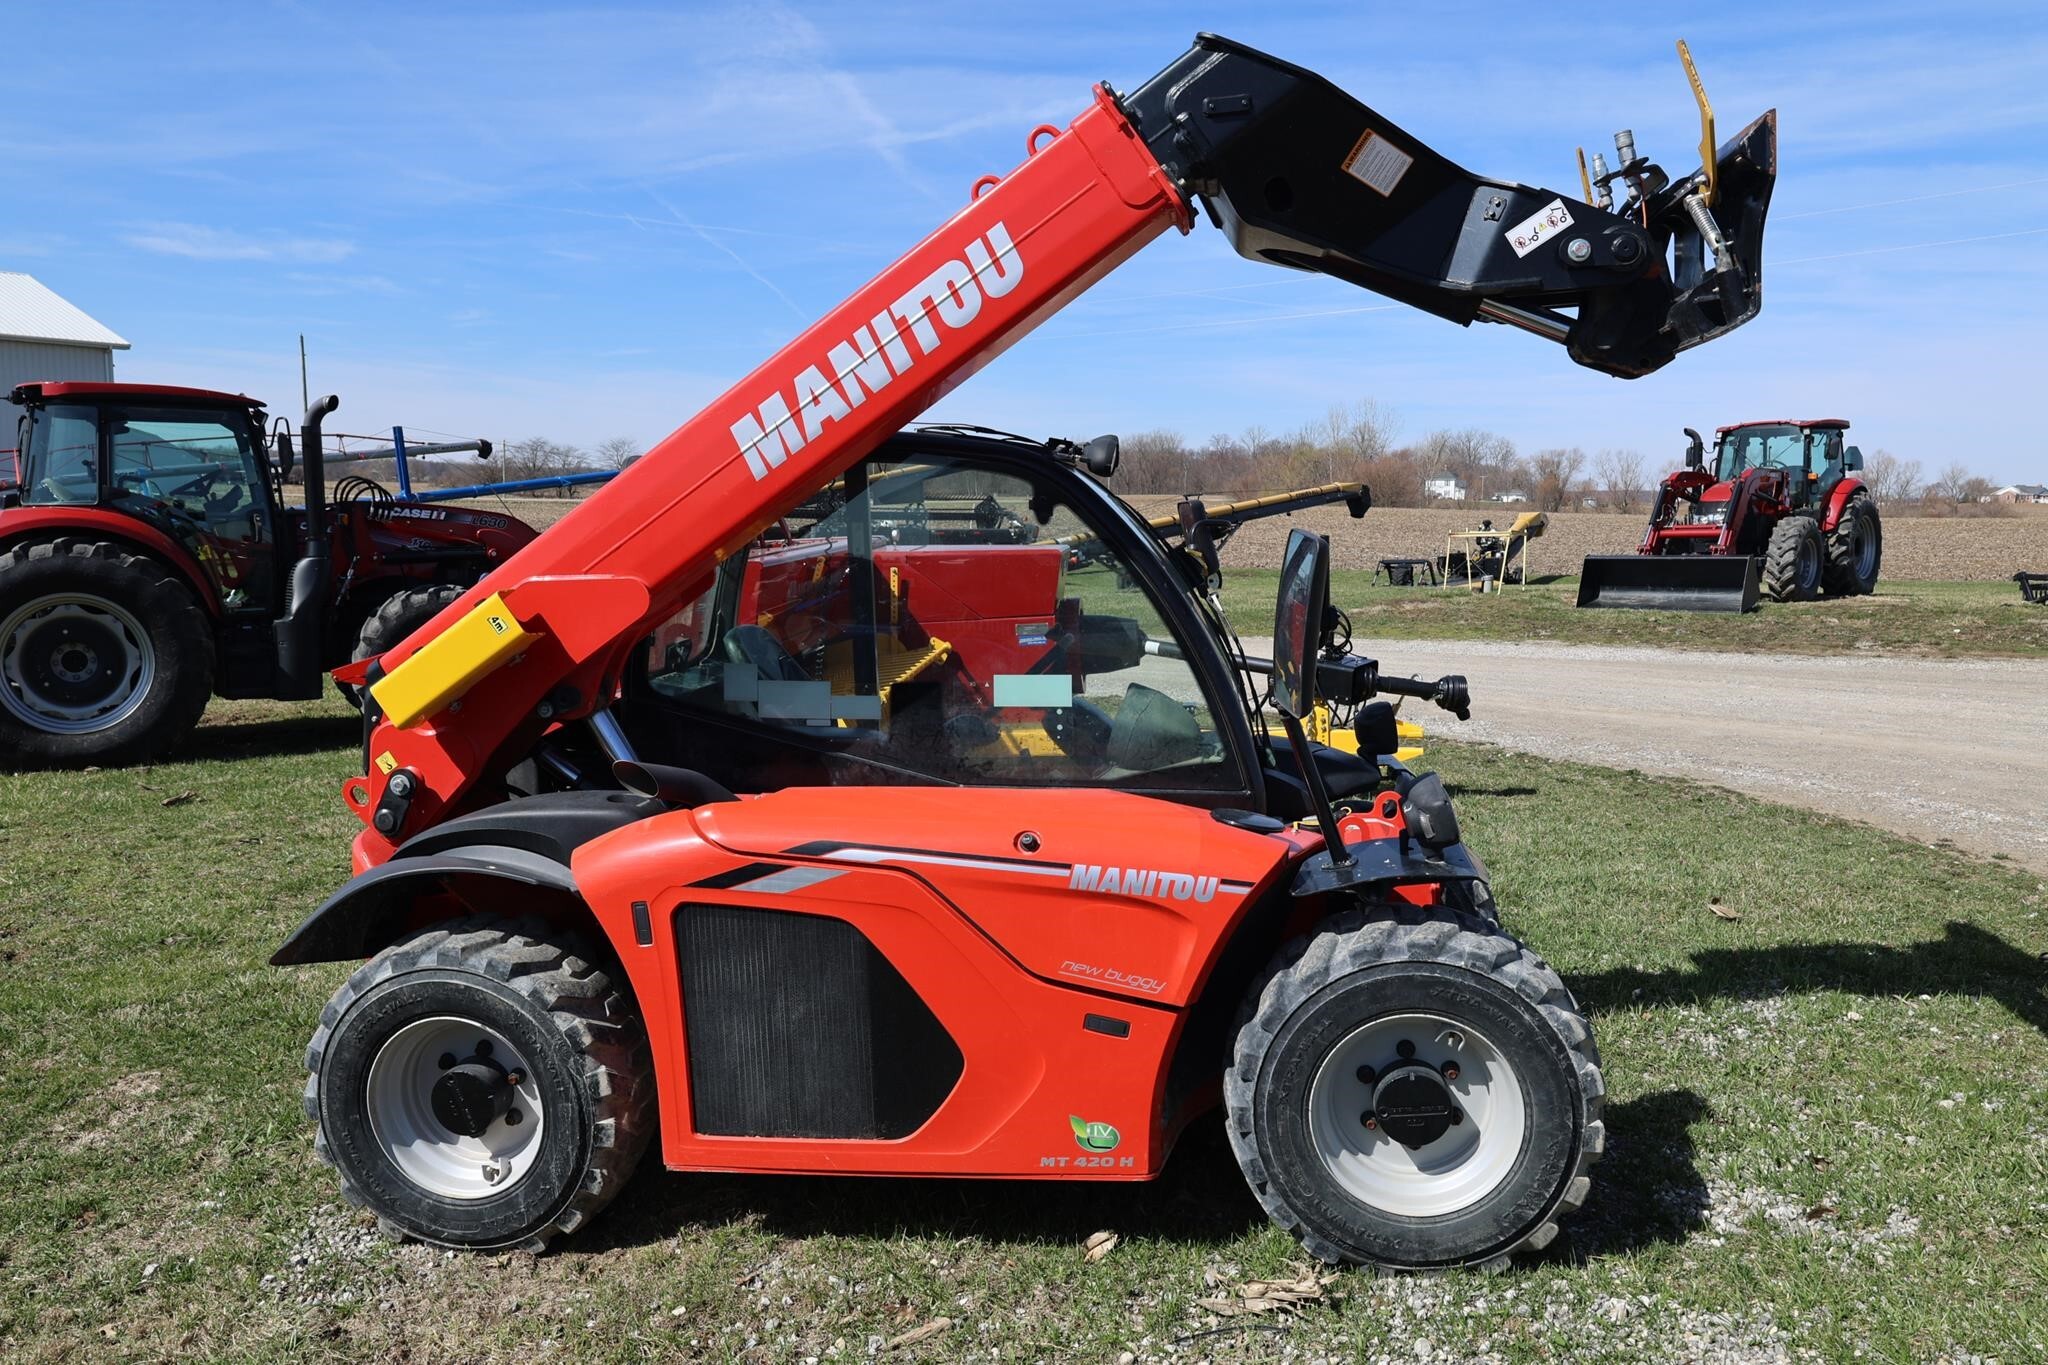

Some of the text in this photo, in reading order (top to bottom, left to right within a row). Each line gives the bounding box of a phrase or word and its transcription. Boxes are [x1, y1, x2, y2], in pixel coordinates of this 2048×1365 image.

[730, 221, 1024, 481] MANITOU
[390, 507, 431, 520] CASE
[472, 515, 508, 529] L630
[491, 616, 504, 632] 4m
[1070, 864, 1218, 902] MANITOU
[1060, 960, 1167, 993] new buggy
[1094, 1125, 1113, 1137] IV
[1040, 1156, 1135, 1168] MT 420 H
